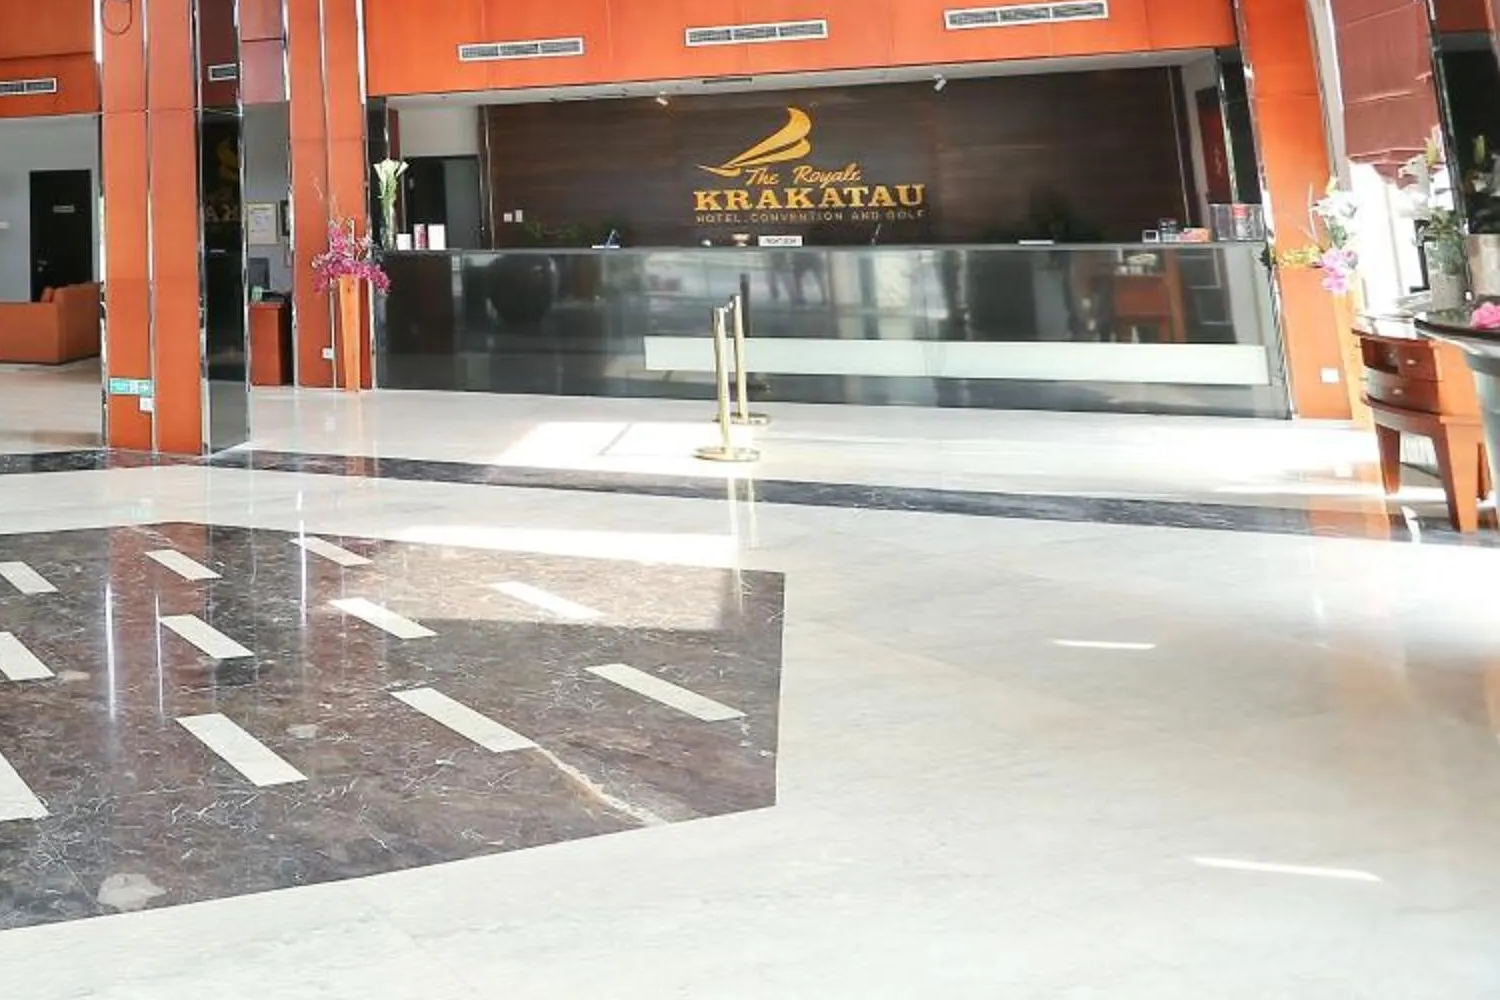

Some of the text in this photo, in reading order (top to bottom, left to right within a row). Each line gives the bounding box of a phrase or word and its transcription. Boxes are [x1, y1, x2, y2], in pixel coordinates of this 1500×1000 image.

[745, 163, 861, 189] The Royale
[693, 184, 925, 211] KRAKATAU
[751, 211, 843, 223] CONVENTION
[852, 211, 879, 221] AND
[886, 209, 925, 221] GOLF
